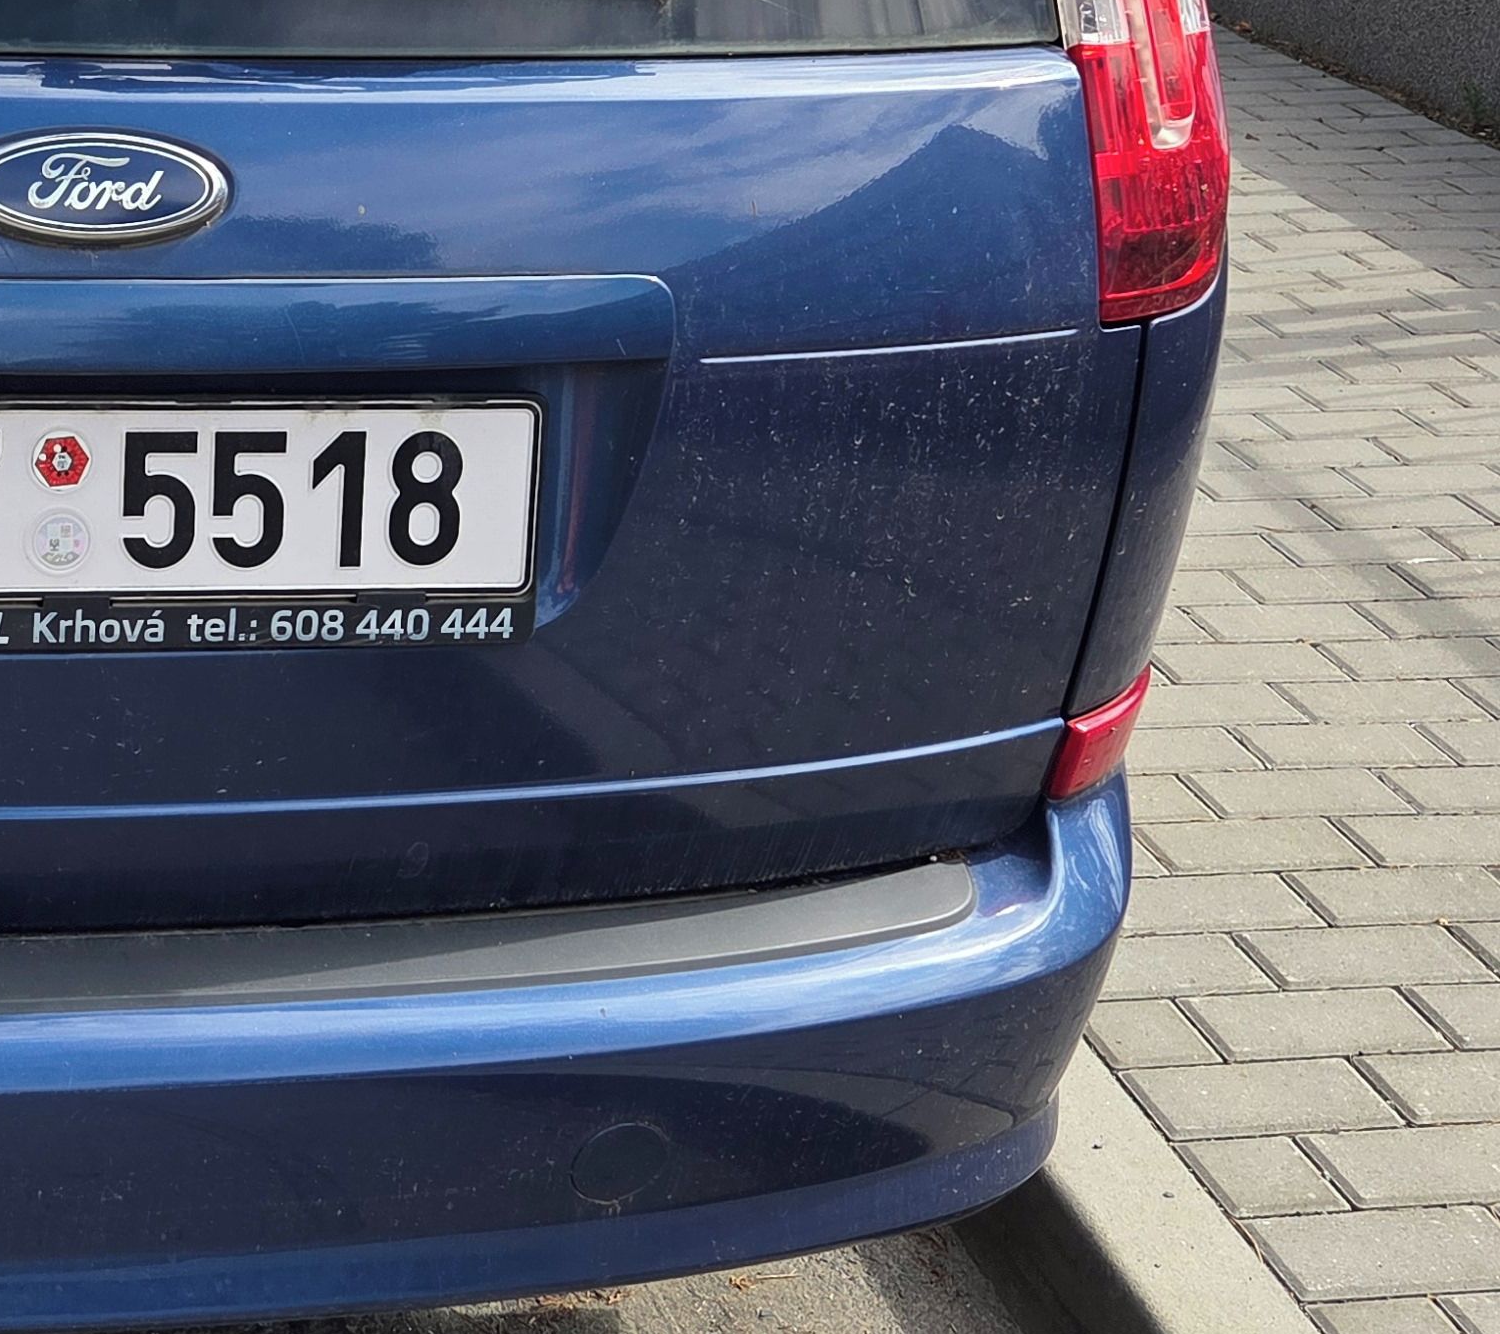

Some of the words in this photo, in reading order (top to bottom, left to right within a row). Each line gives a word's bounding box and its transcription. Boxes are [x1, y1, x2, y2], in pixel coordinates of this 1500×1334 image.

[27, 152, 165, 211] Ford
[120, 430, 464, 571] 5518
[31, 609, 165, 644] Krhová
[187, 609, 258, 642] tel.:
[270, 608, 345, 641] 608
[354, 608, 429, 641] 440
[440, 607, 515, 640] 444
